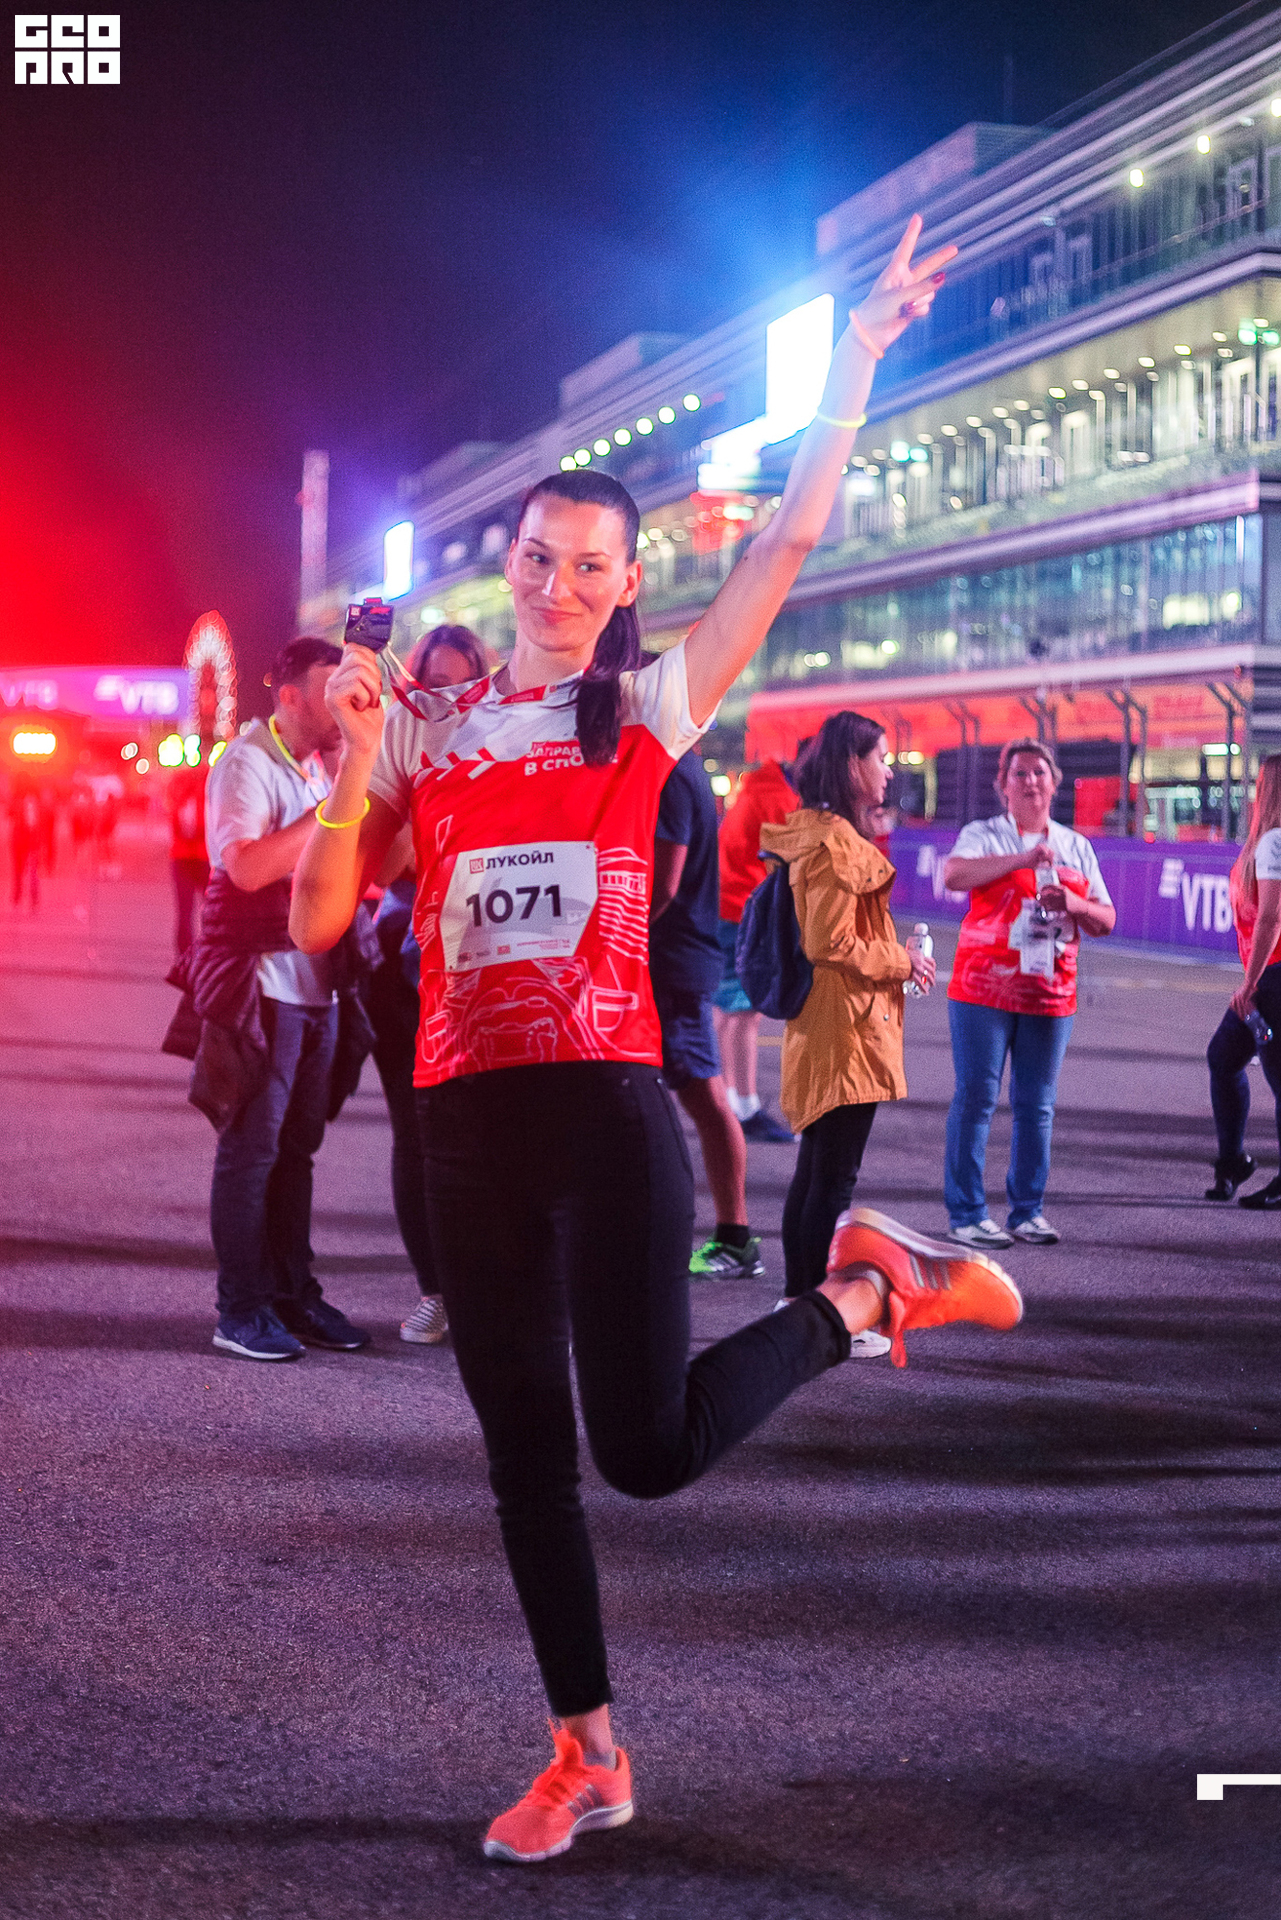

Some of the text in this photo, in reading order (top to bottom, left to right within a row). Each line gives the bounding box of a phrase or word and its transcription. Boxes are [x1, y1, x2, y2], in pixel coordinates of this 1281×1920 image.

[486, 850, 554, 870] ЛУКОЙЛ
[465, 884, 562, 928] 1071
[1181, 871, 1234, 934] VTB
